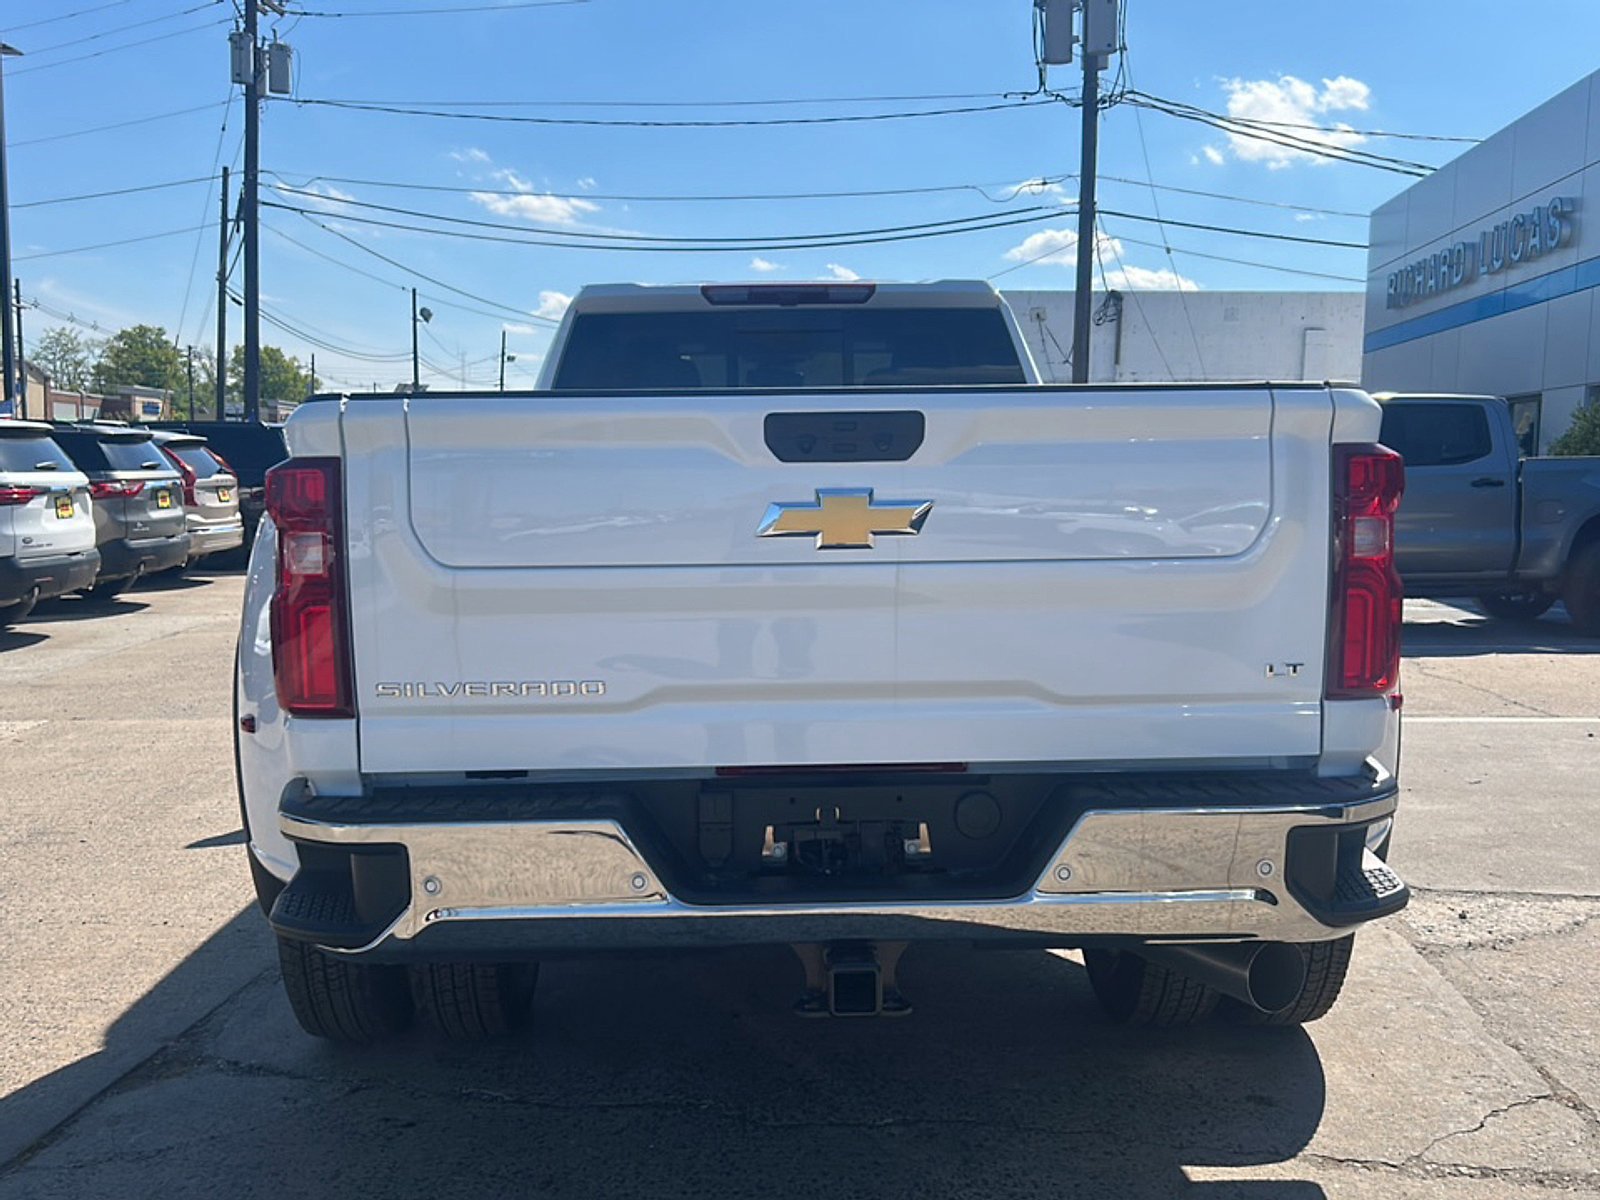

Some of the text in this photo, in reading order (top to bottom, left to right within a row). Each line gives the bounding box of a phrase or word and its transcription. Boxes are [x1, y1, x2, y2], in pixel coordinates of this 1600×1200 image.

[1387, 197, 1574, 309] RICHARD LUCAS
[1265, 662, 1305, 678] LT
[375, 680, 607, 697] SILVERADO
